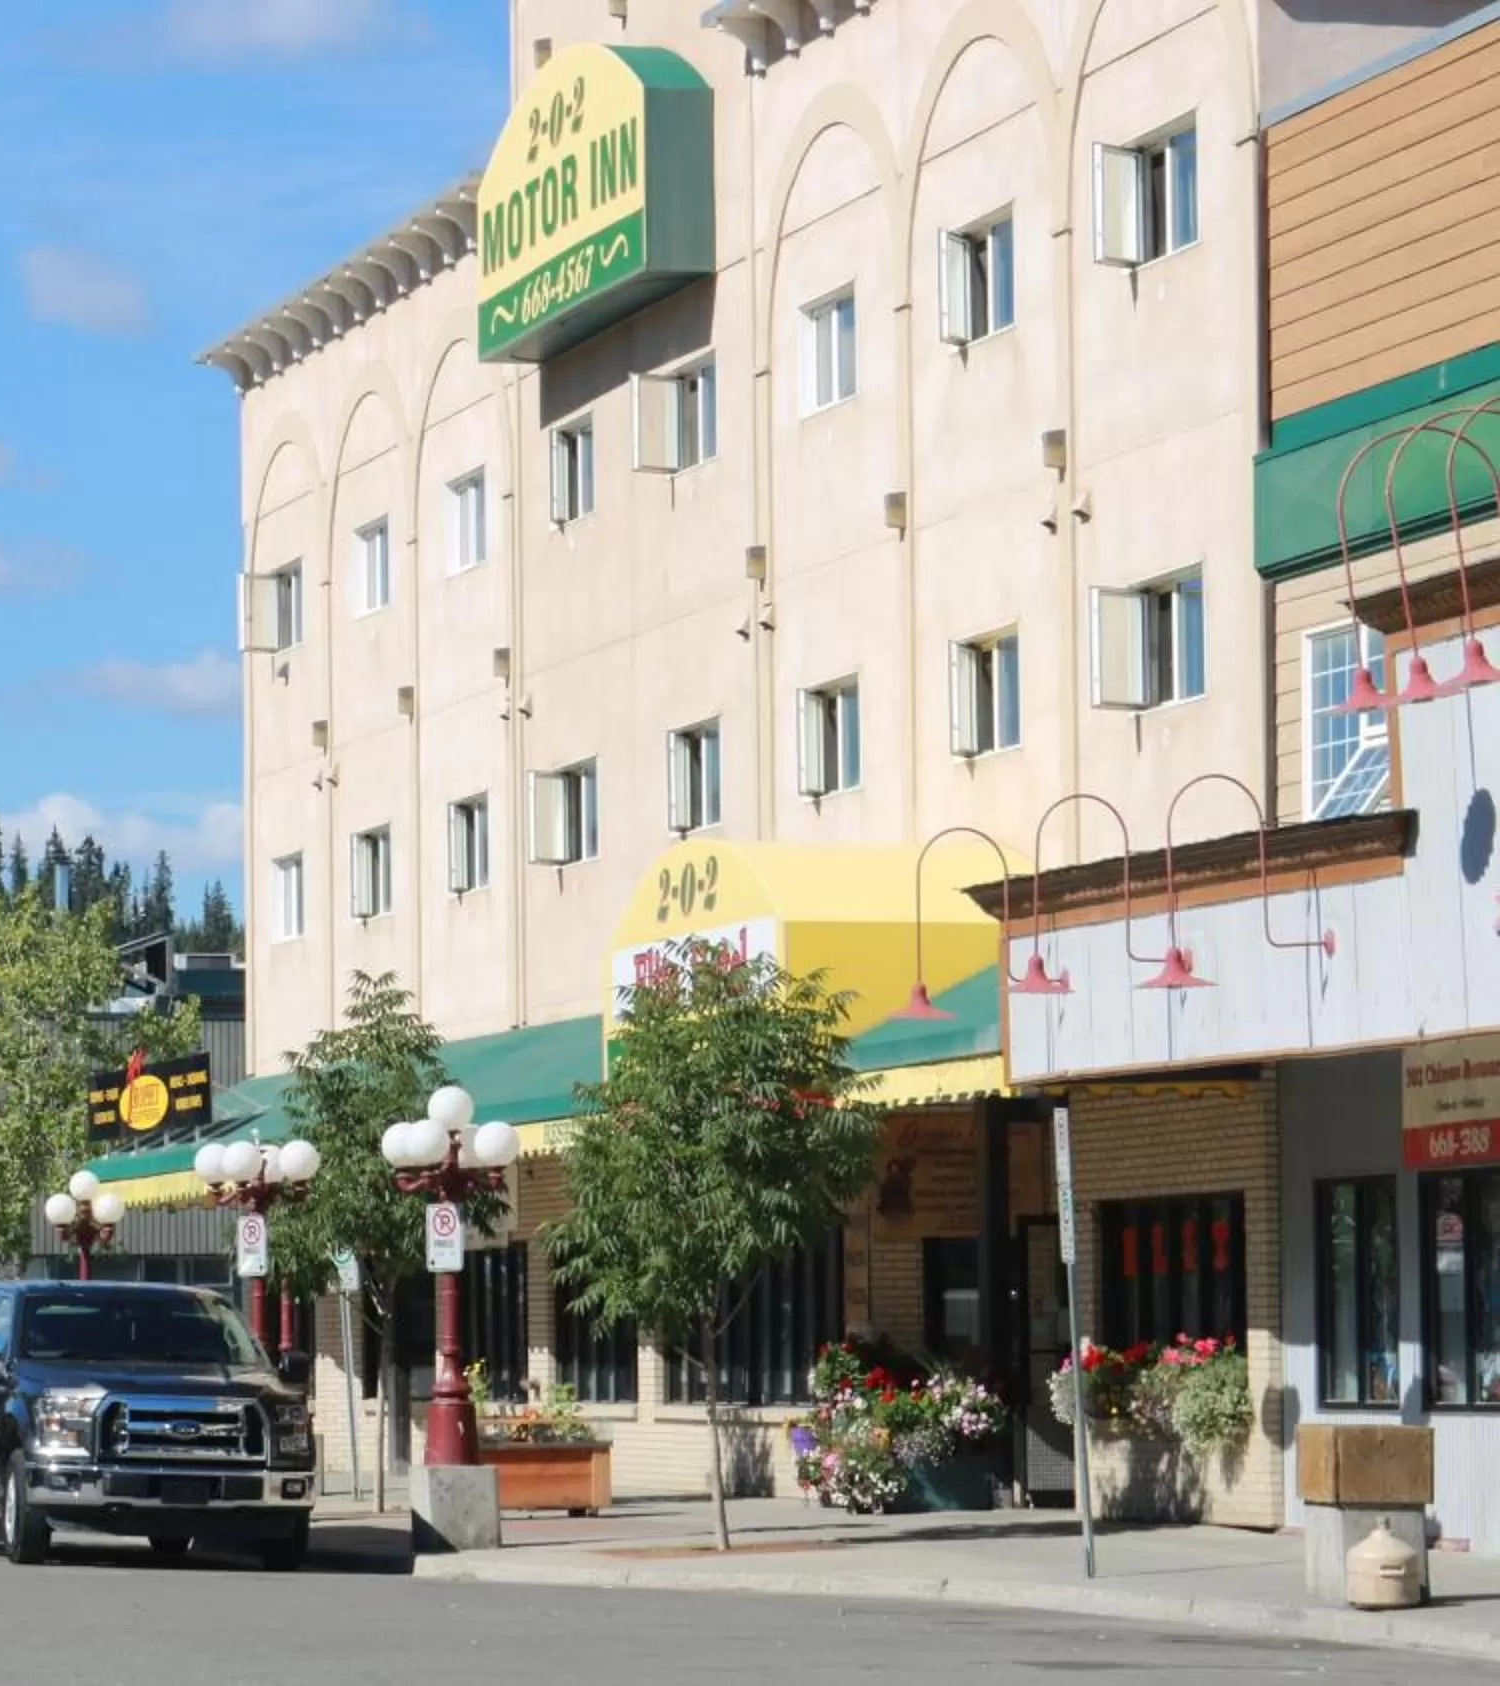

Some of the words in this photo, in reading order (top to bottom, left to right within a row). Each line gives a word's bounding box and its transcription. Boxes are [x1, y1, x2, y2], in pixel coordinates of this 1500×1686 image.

[483, 154, 578, 277] MOTOR
[590, 116, 637, 211] INN
[521, 244, 595, 325] 668-4567
